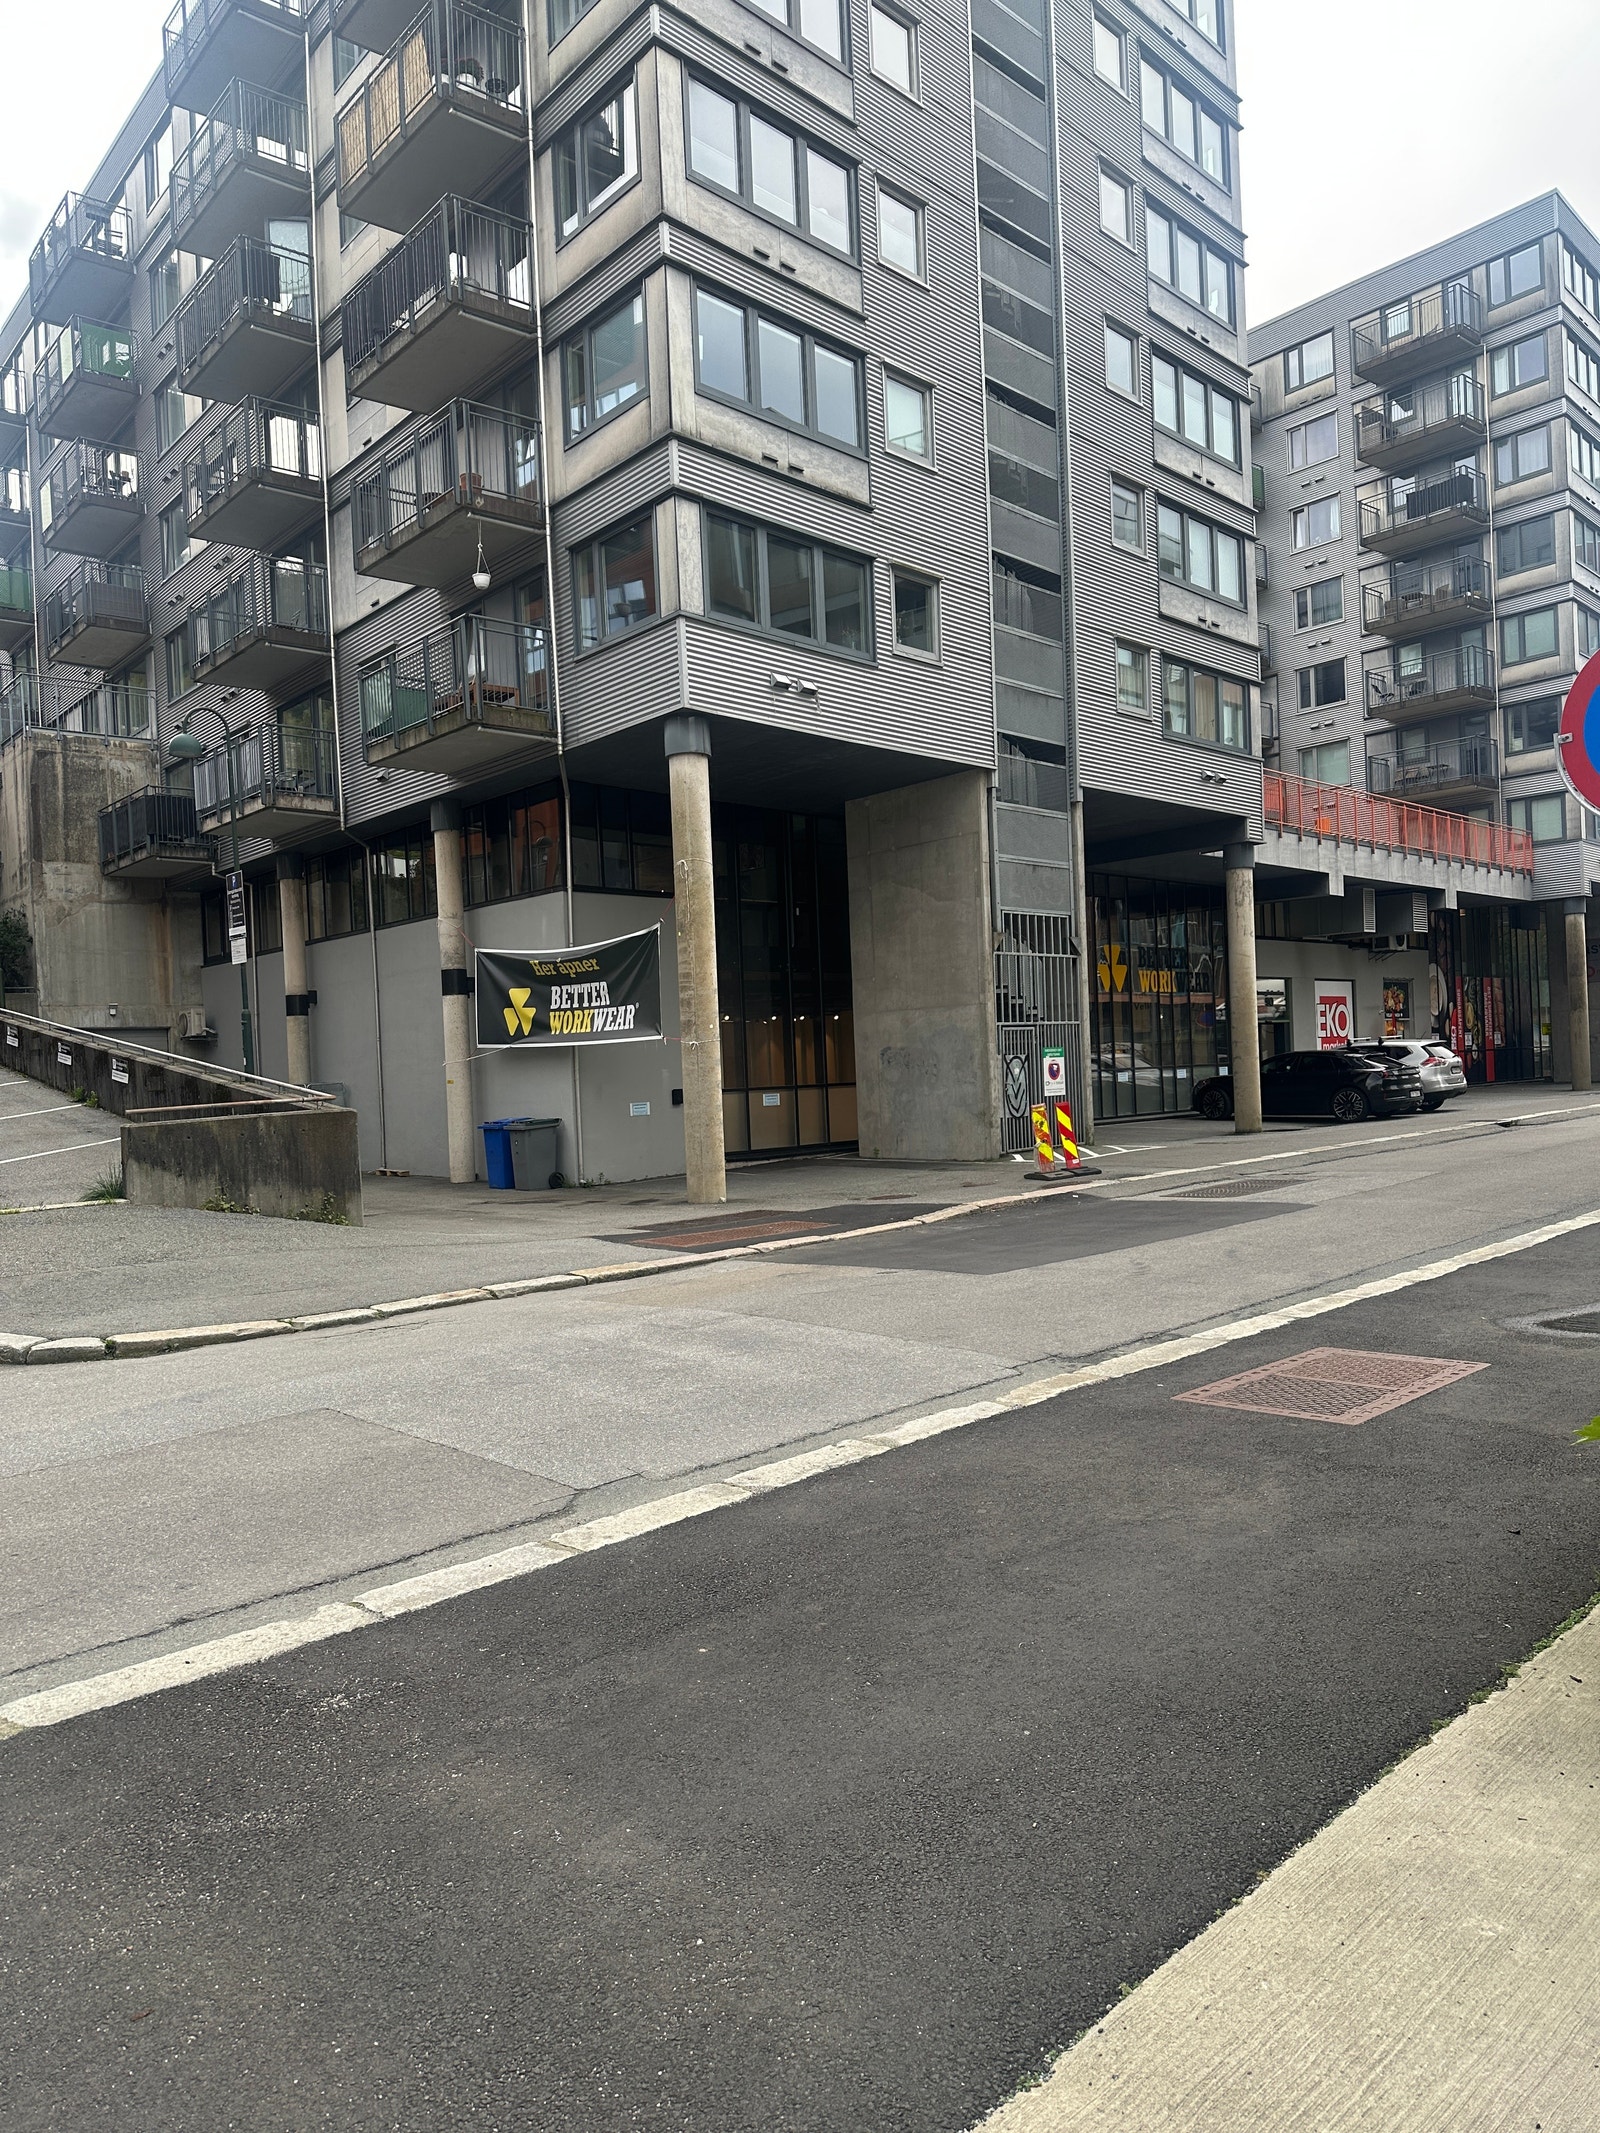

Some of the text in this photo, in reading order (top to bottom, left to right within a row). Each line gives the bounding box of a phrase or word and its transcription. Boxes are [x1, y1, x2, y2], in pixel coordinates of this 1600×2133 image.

[529, 958, 600, 977] Her åpner
[550, 981, 610, 1010] BETTER
[549, 1004, 636, 1035] WORKWEAR
[1316, 1003, 1350, 1037] EKO
